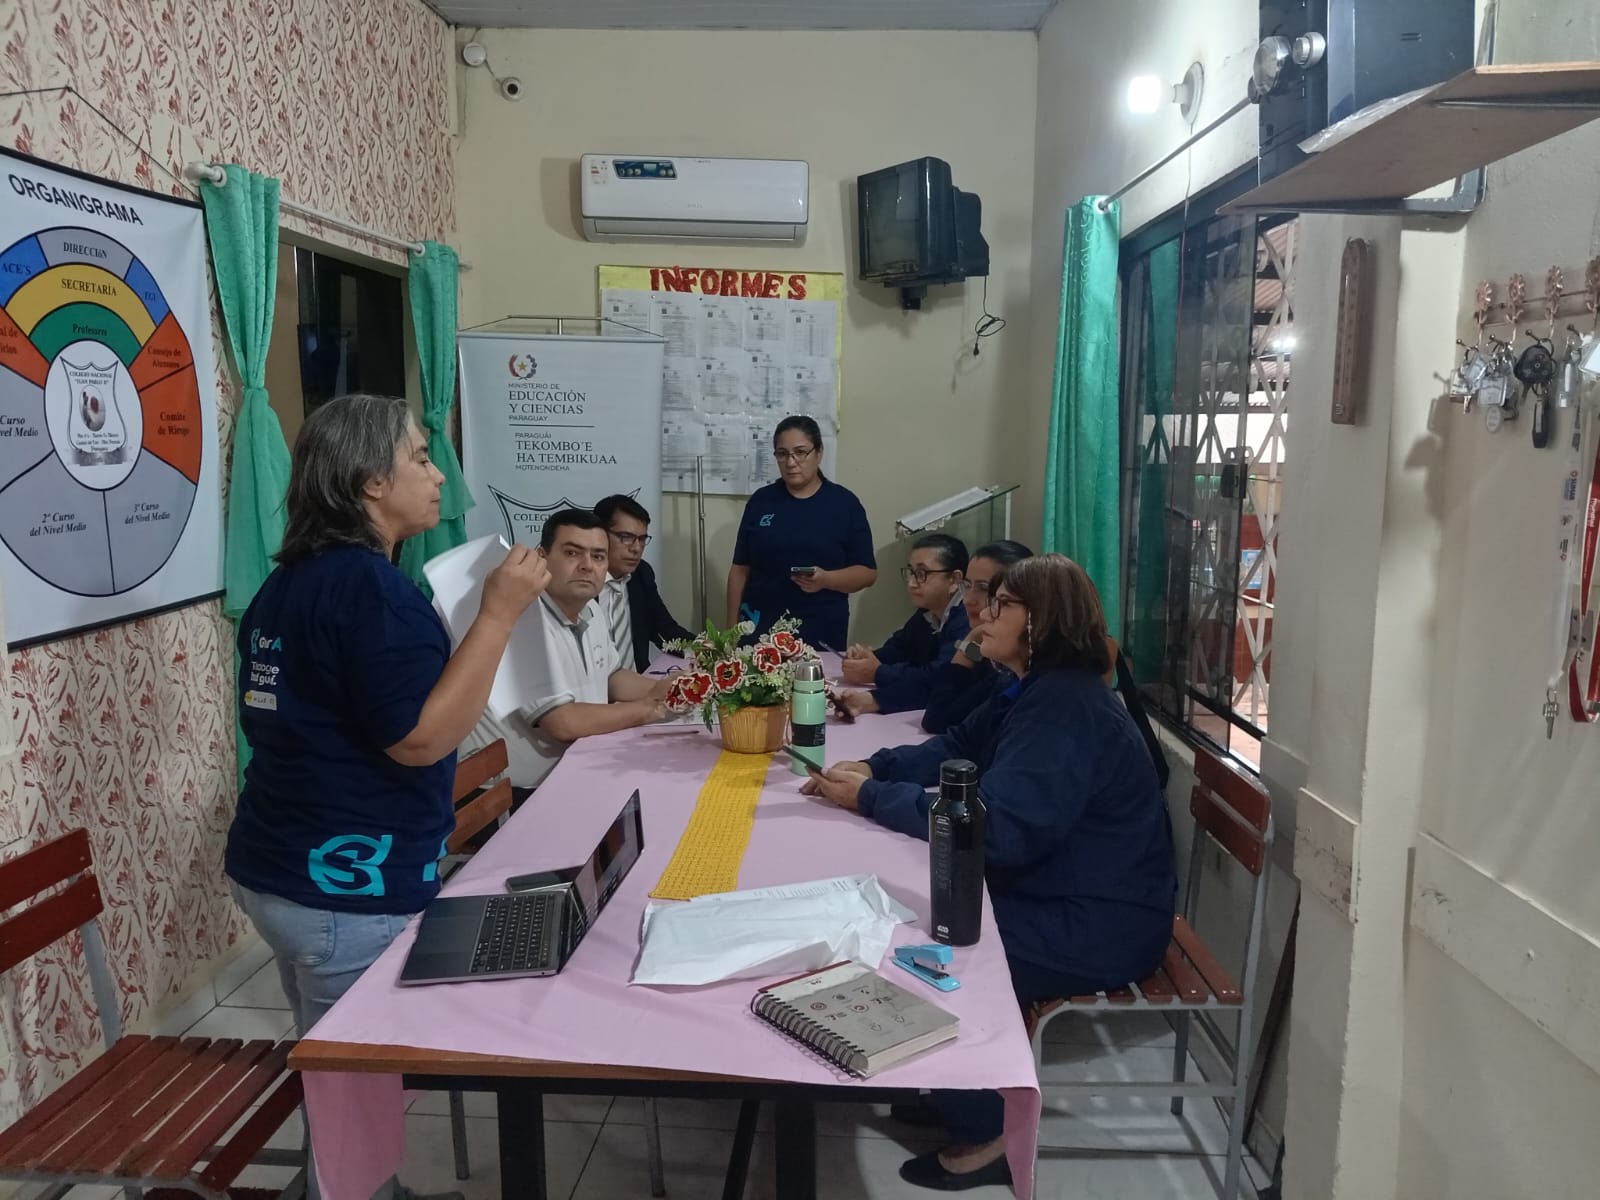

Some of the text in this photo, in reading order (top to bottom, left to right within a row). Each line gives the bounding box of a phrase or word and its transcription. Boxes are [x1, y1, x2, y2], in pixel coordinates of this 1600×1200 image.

[8, 174, 144, 226] ORGANIGRAMA
[61, 278, 117, 297] SECRETARÍA
[650, 265, 807, 300] INFORMES
[508, 382, 548, 390] MINISTERIO
[508, 389, 587, 402] EDUCACIÓN
[509, 403, 584, 415] Y CIENCIAS
[508, 414, 549, 422] PARAGUAY
[516, 452, 618, 464] HA TEMBIKUAA
[140, 502, 160, 512] Curso
[52, 511, 75, 522] Curso
[43, 524, 64, 535] Nivel
[66, 522, 87, 532] Medio
